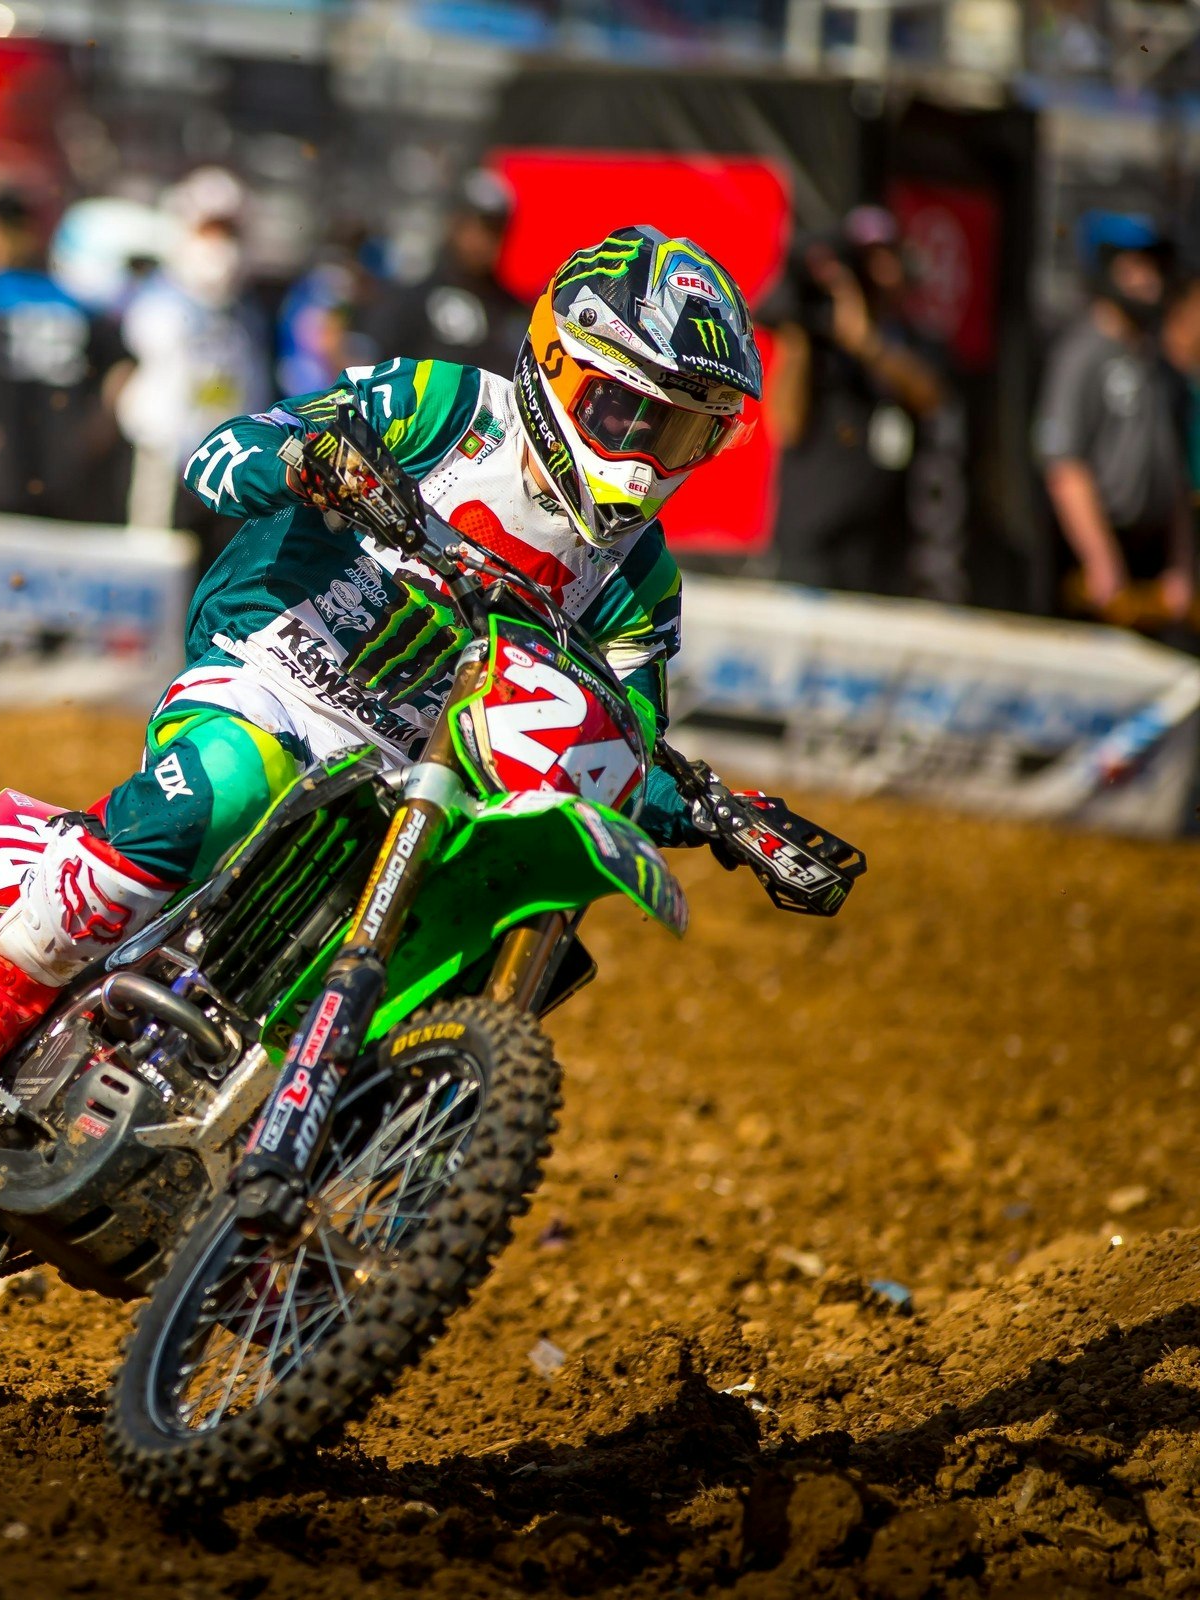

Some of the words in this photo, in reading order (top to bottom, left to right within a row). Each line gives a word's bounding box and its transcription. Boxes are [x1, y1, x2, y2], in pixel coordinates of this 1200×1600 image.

[676, 276, 717, 298] BELL
[682, 354, 754, 388] MONSTER
[696, 365, 747, 388] ENERGY
[521, 355, 556, 449] MONSTER
[475, 443, 493, 465] 360
[532, 491, 565, 517] FOX
[628, 482, 649, 494] BELL
[345, 568, 382, 607] DUNLOP
[316, 597, 335, 620] PPG
[154, 752, 194, 801] FOX
[397, 808, 427, 860] PRO
[363, 854, 407, 941] CIRCUIT
[390, 1020, 466, 1057] DUNLOP
